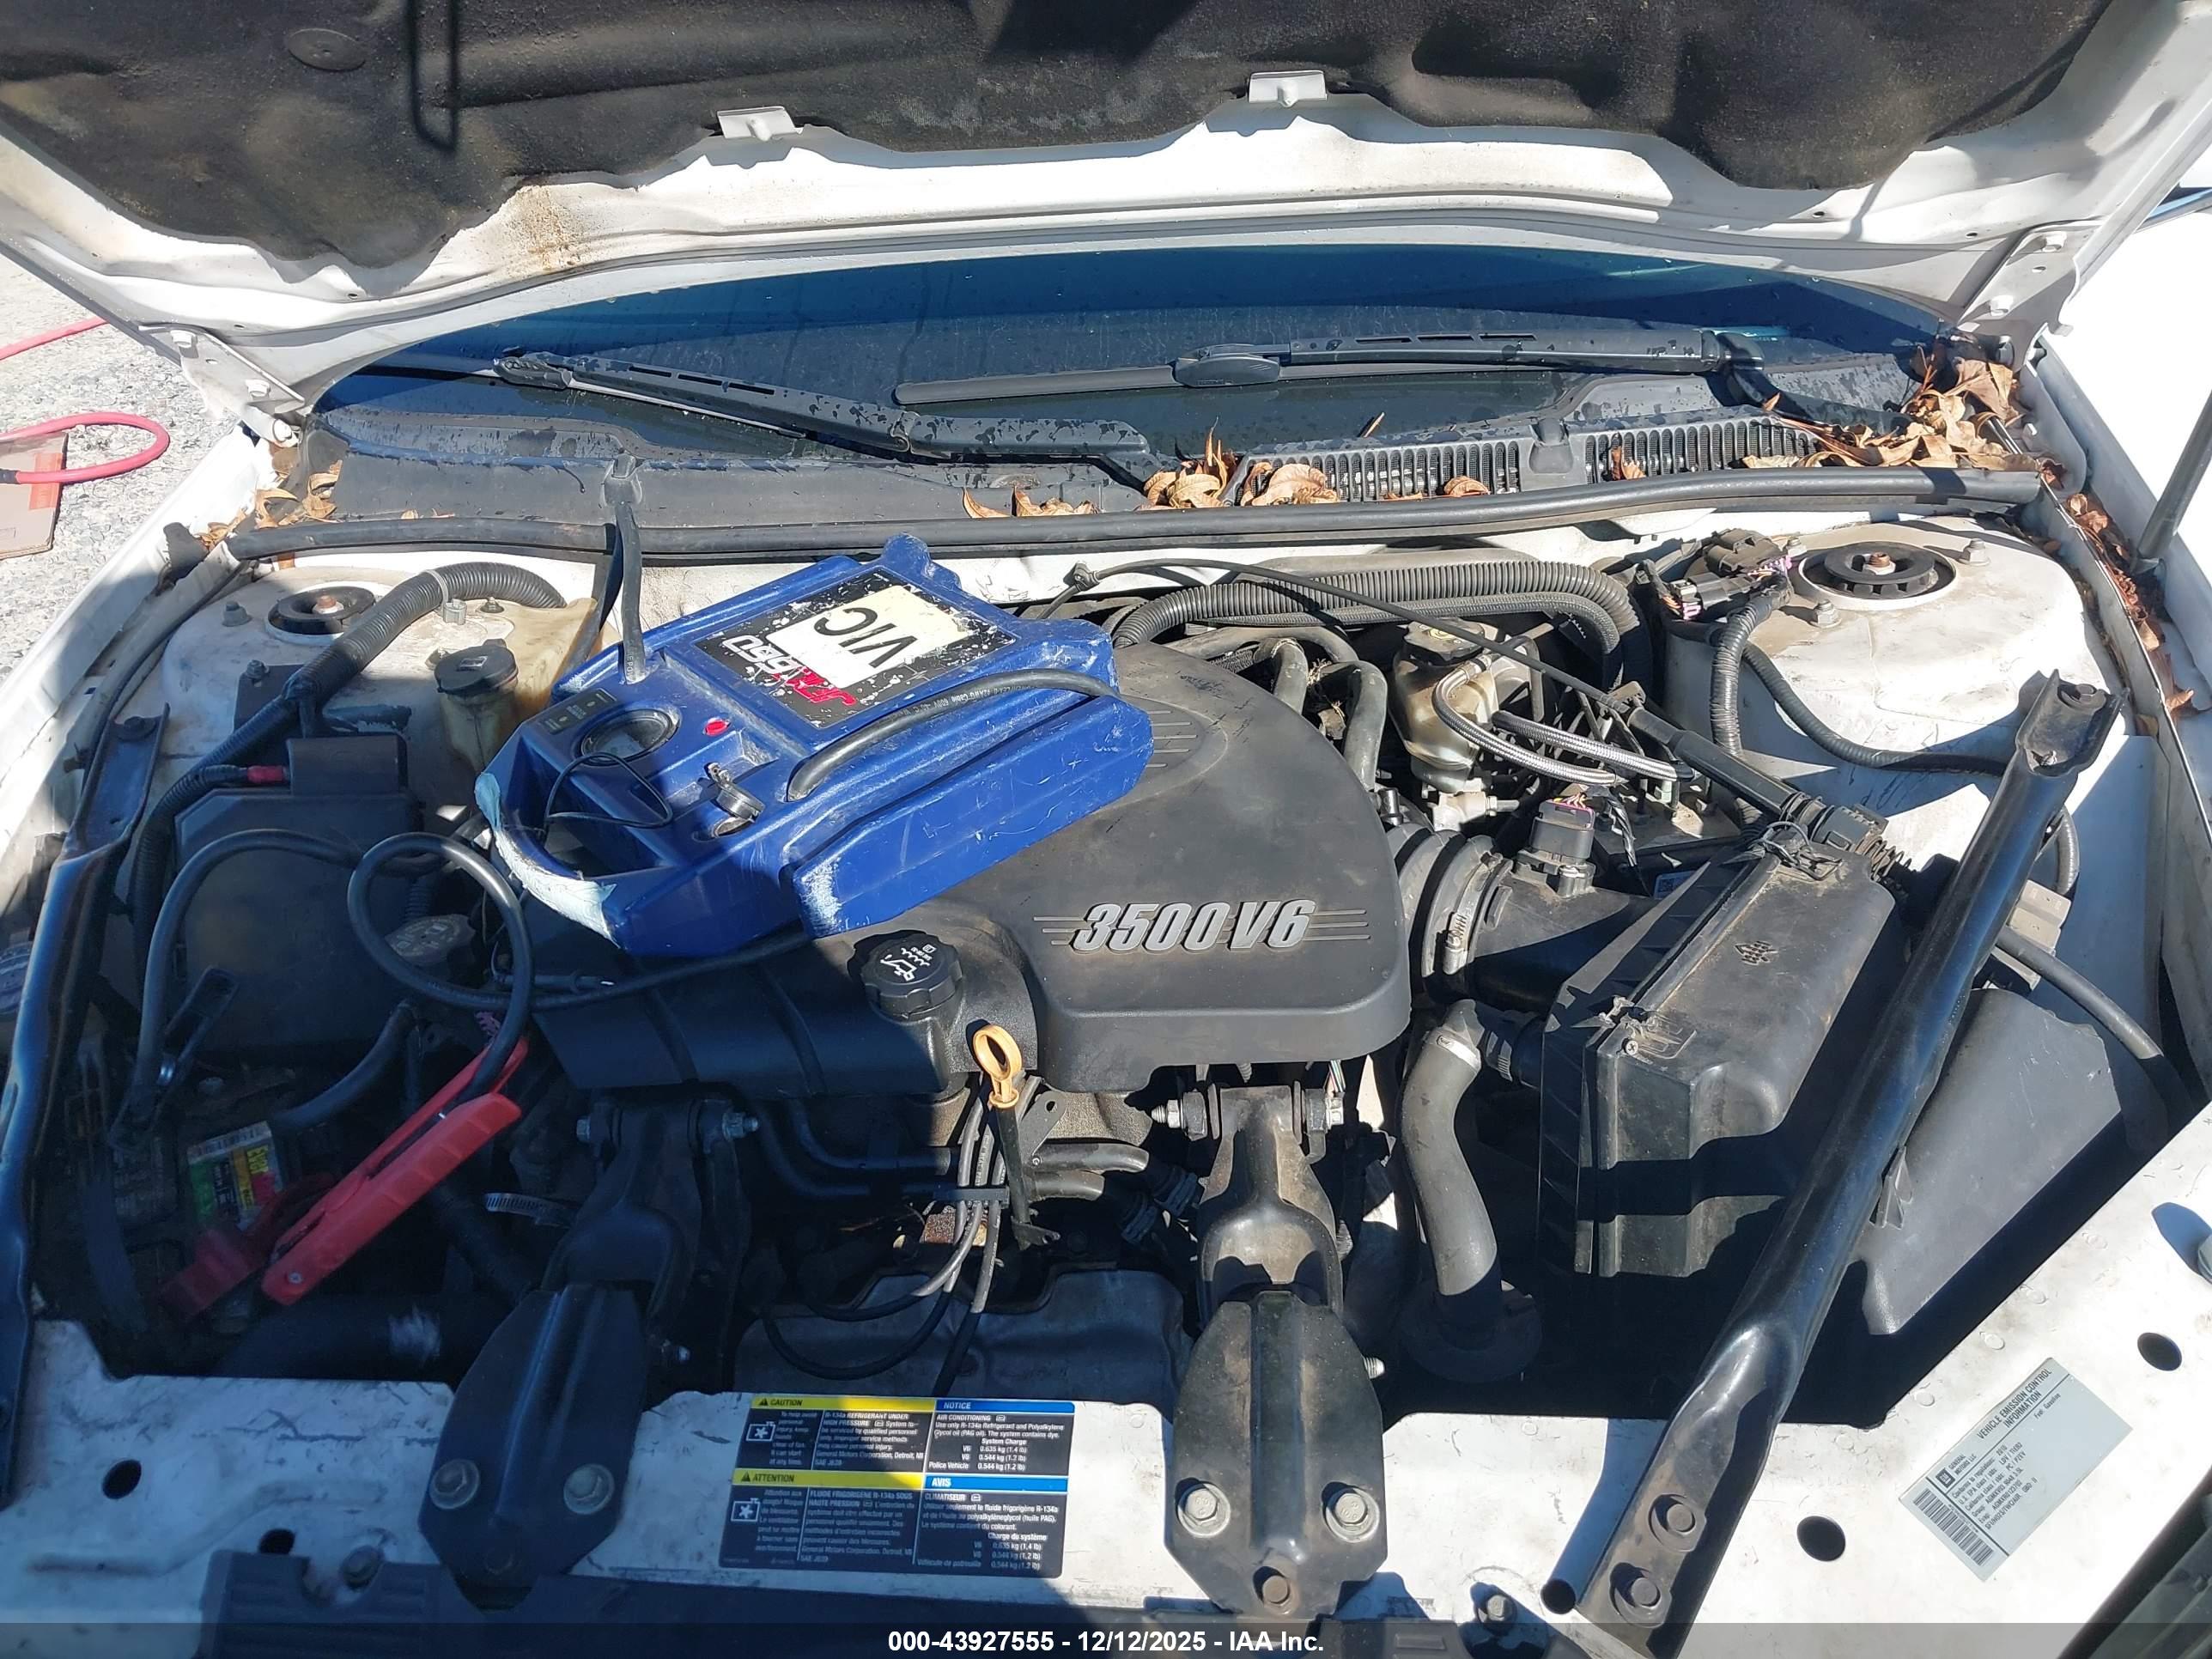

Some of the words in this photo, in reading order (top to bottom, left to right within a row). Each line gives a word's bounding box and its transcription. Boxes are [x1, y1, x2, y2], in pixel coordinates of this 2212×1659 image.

[814, 606, 918, 669] VIC
[1073, 901, 1231, 951] 3500
[1228, 899, 1316, 950] V6
[1976, 1414, 2002, 1440] VEHICLE
[1998, 1389, 2028, 1418] EMISSION
[2023, 1366, 2052, 1394] CONTROL
[2002, 1389, 2043, 1428] INFORMATION
[981, 1422, 1014, 1431] Refrigerant
[1948, 1452, 1966, 1470] GENERAL
[752, 1474, 795, 1482] ATTENTION
[931, 1477, 951, 1486] AVIS
[924, 1492, 967, 1501] CLIMATISEUR
[987, 1532, 1010, 1540] Charge
